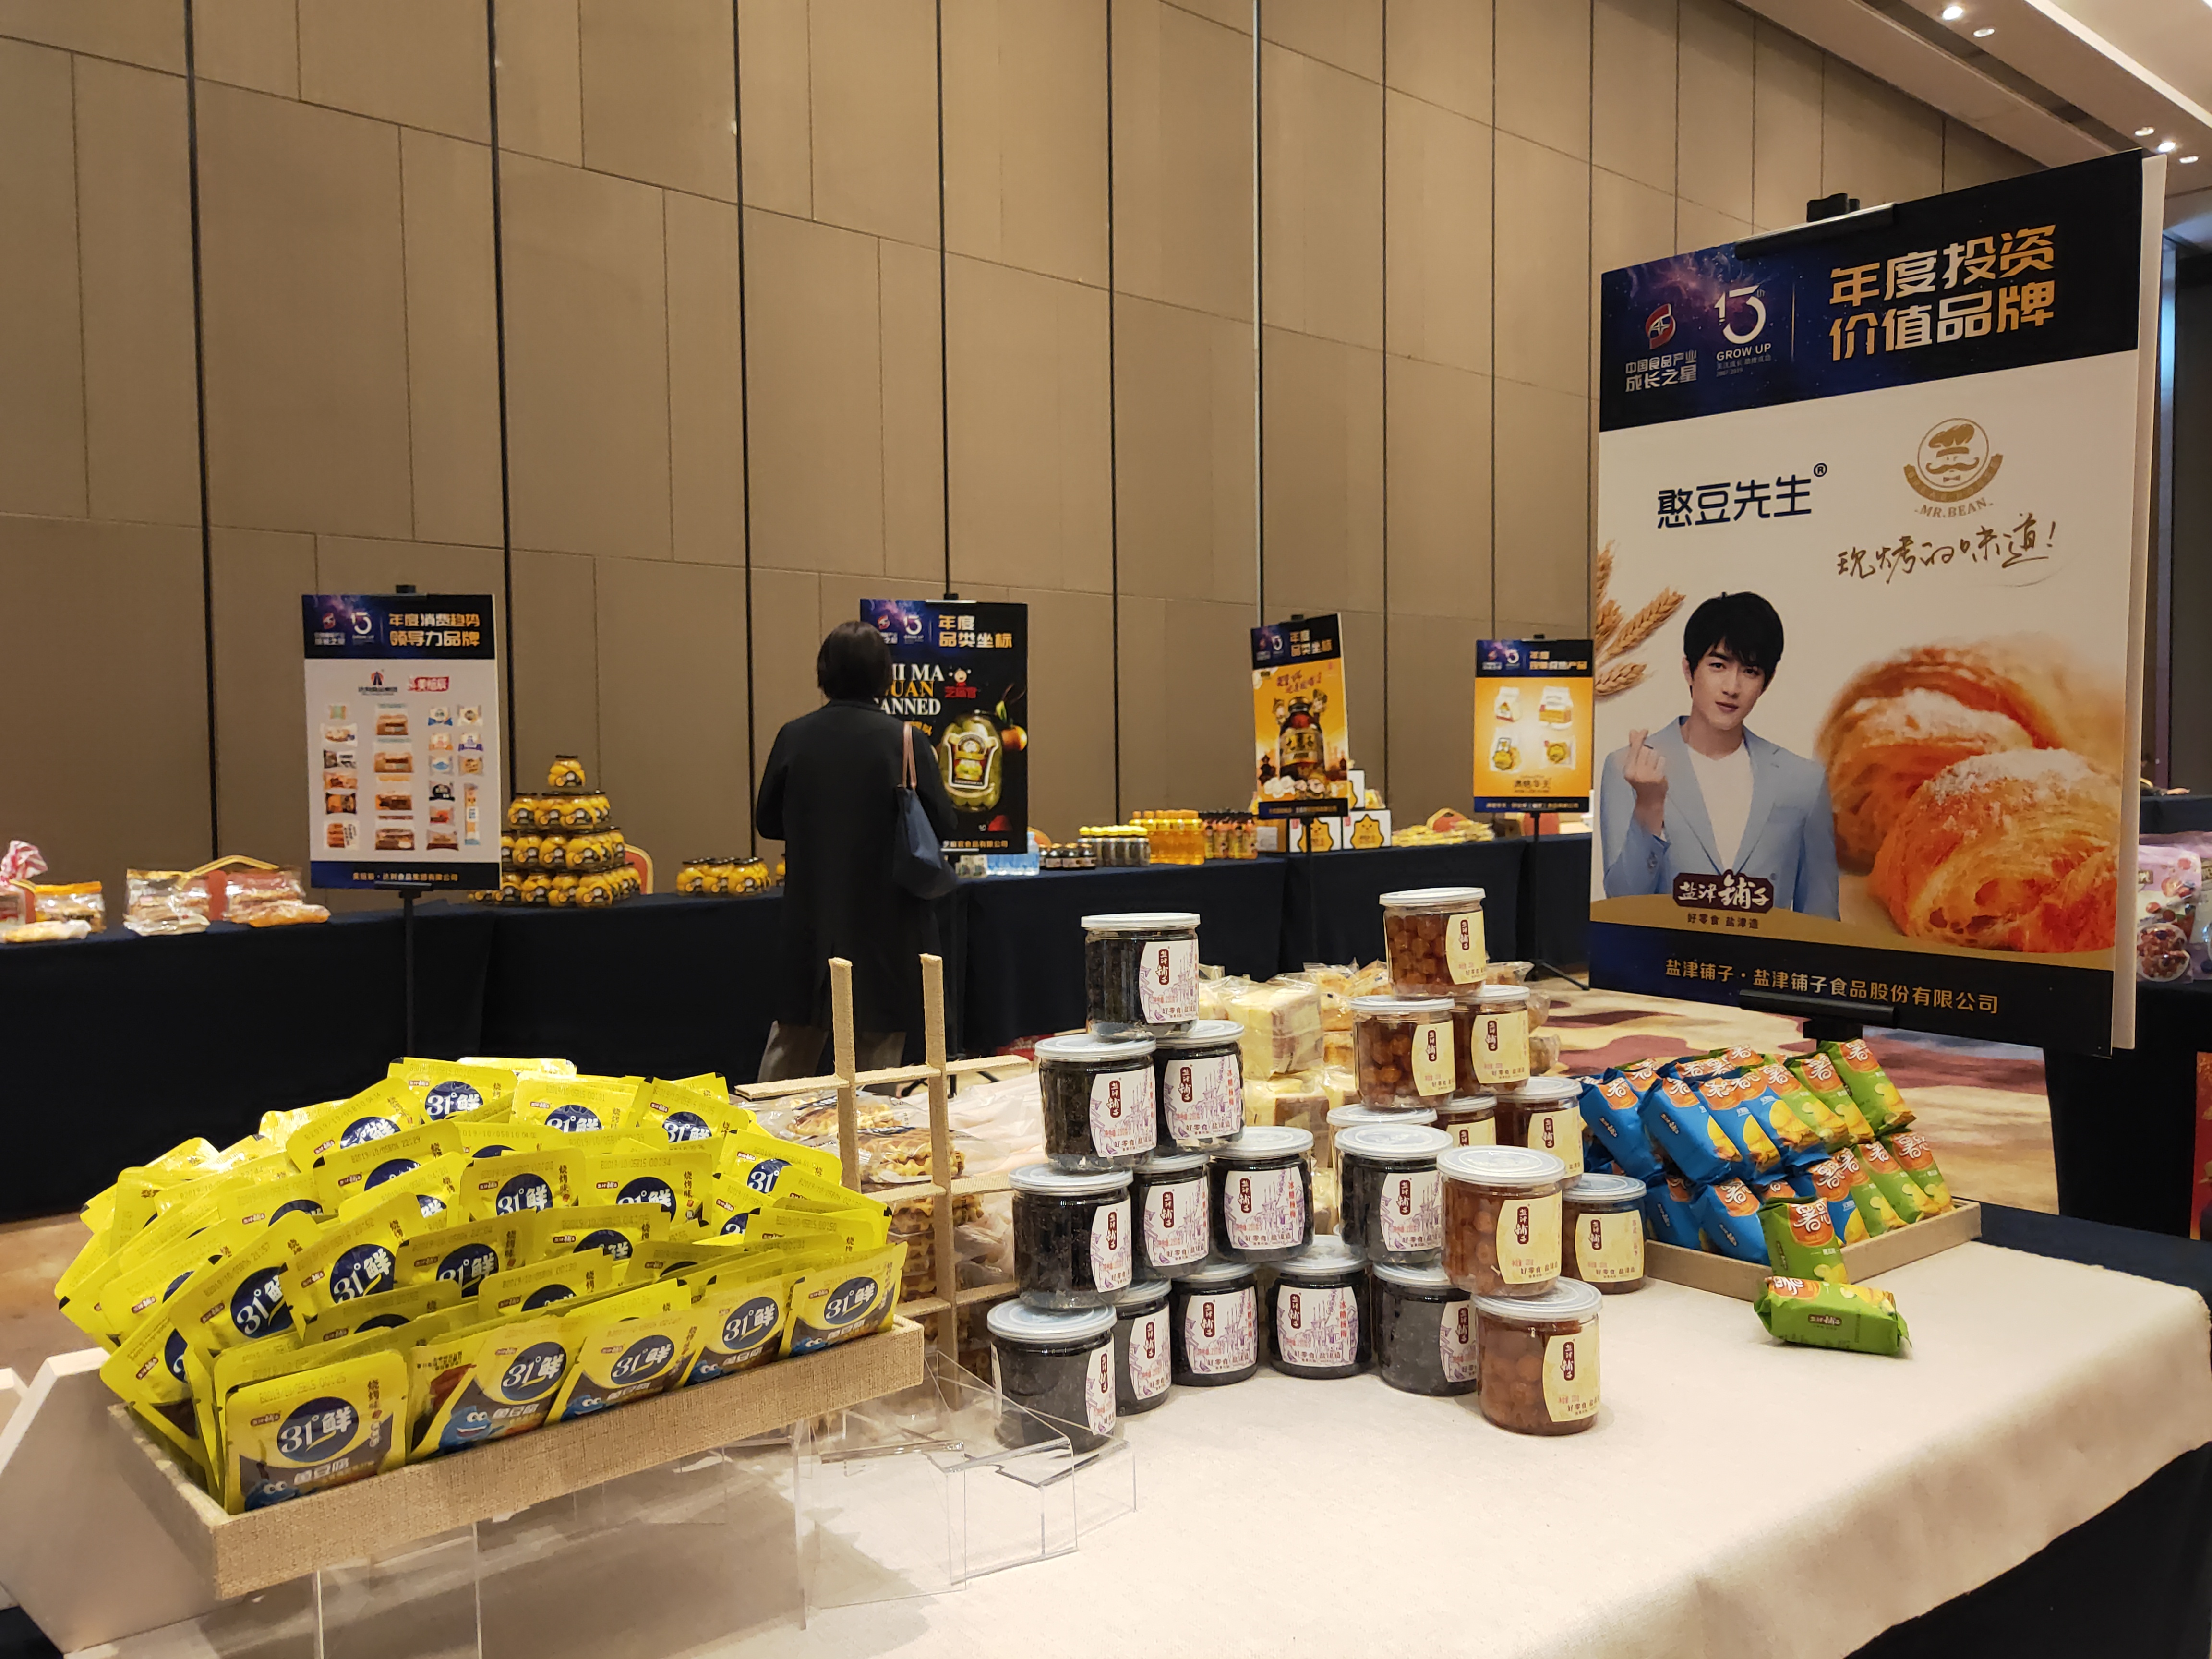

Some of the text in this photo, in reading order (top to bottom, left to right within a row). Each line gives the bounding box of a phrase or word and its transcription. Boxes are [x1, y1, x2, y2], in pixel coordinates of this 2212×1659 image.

[1829, 225, 2055, 310] 年度投资
[1829, 281, 2055, 361] 价值品牌
[1625, 349, 1697, 374] 中国食品产业
[1716, 343, 1771, 361] GROW UP
[1625, 364, 1696, 392] 成长之星
[1658, 474, 1812, 529] 憨豆先生
[388, 613, 480, 627] 年度消费趋势
[938, 615, 975, 630] 年度
[389, 630, 480, 647] 领导力品牌
[939, 632, 1012, 648] 品类坐标
[911, 664, 944, 681] MA
[886, 680, 935, 697] UAN
[875, 698, 941, 715] ANNED
[1678, 874, 1769, 909] 盐津铺子
[1687, 913, 1719, 926] 好零食
[334, 1248, 391, 1303] 31°鲜
[825, 1282, 875, 1319] 31°鲜
[724, 1303, 775, 1342] 31°鲜
[503, 1354, 565, 1387] 31°鲜
[613, 1344, 672, 1377] 31°鲜
[281, 1406, 352, 1453] 31°鲜
